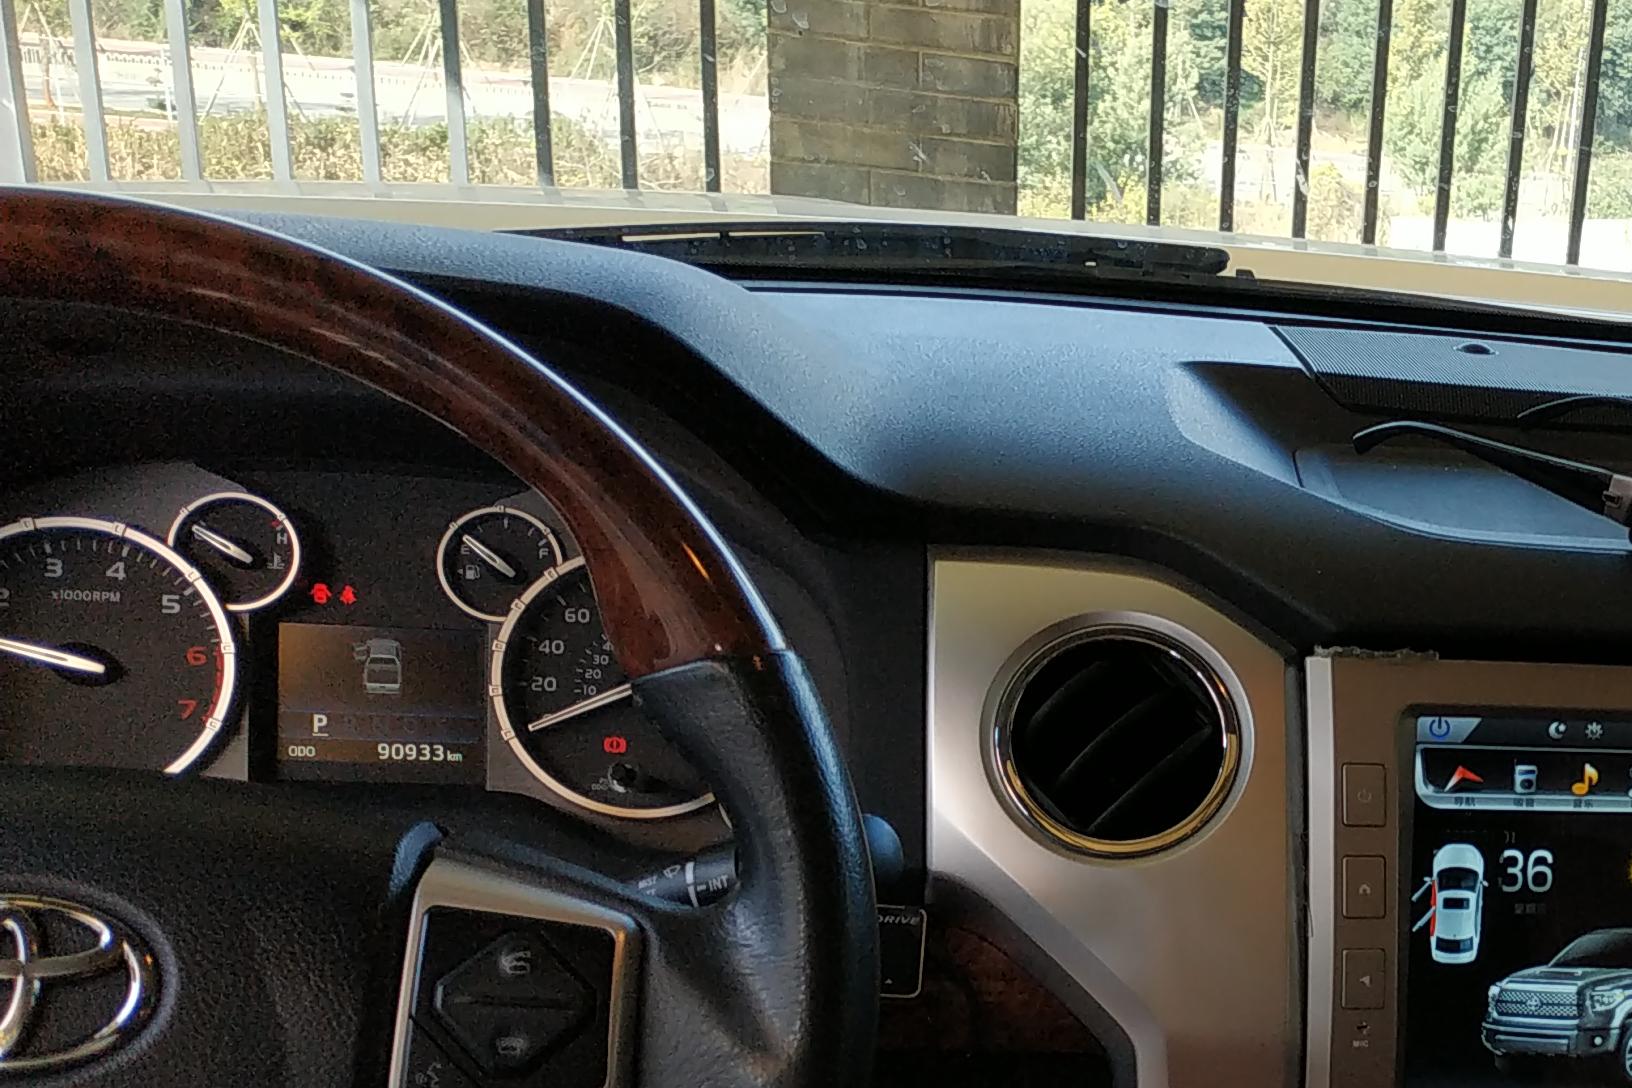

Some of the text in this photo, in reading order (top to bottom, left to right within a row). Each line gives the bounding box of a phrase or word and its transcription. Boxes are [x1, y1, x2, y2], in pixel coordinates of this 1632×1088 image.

[276, 532, 288, 545] H
[461, 544, 471, 555] E
[538, 547, 549, 559] F
[44, 558, 63, 577] 3
[105, 561, 126, 580] 4
[161, 594, 181, 614] 5
[564, 608, 590, 623] 60
[538, 639, 565, 654] 40
[186, 646, 208, 666] 6
[592, 655, 610, 665] 30
[584, 669, 602, 679] 20
[531, 676, 557, 692] 20
[582, 685, 597, 696] 10
[177, 699, 197, 720] 7
[312, 713, 328, 733] P
[288, 745, 316, 757] ODO
[377, 742, 463, 762] 90933 km
[1500, 848, 1554, 893] 36
[708, 874, 729, 892] INT
